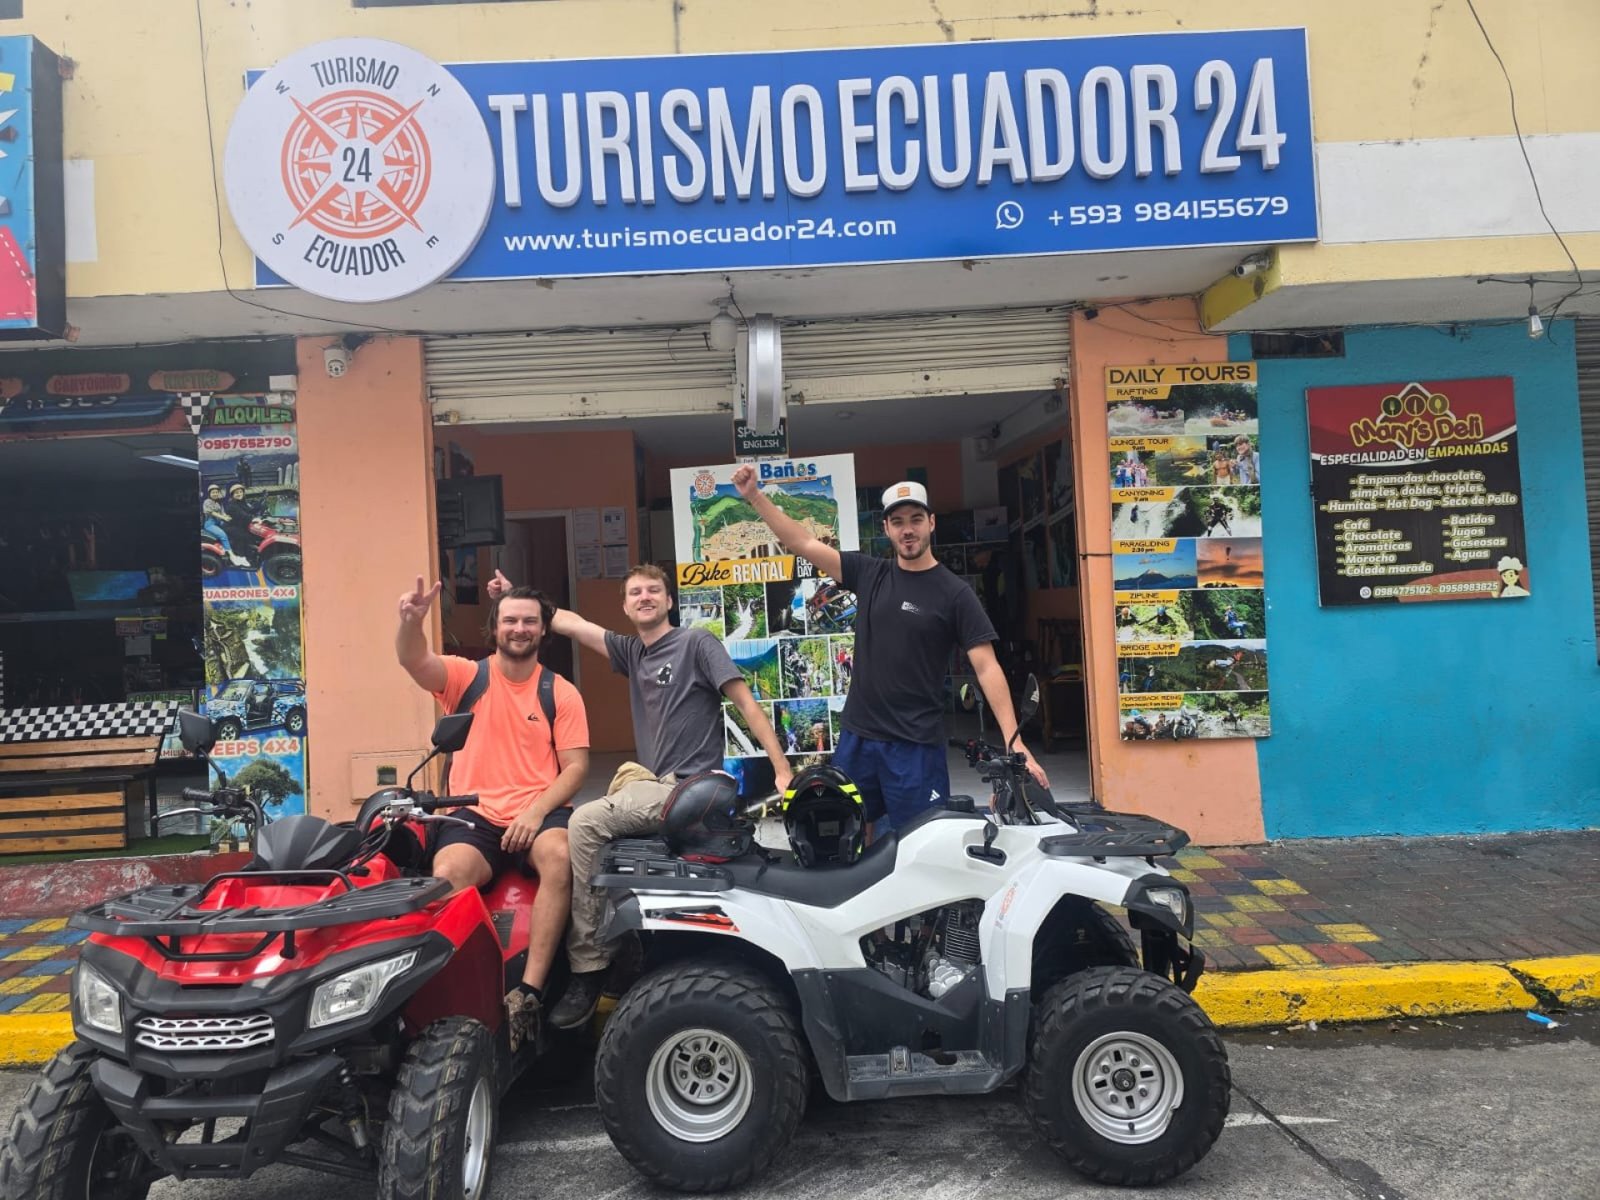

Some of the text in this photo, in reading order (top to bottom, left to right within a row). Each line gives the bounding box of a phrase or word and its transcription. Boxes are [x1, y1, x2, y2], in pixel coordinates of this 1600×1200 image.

[310, 55, 401, 90] TURISMO
[488, 55, 1287, 208] TURISMO ECUADOR 24
[342, 147, 372, 183] 24
[1134, 194, 1290, 223] 984155679
[303, 233, 406, 276] ECUADOR
[1110, 365, 1251, 384] DAILY TOURS
[214, 407, 293, 424] ALQUILER
[1351, 413, 1483, 447] Mary's Deli
[203, 437, 292, 450] 0967652790
[743, 439, 780, 449] ENGLISH
[1111, 438, 1169, 447] JUNGLE TOUR
[1320, 443, 1508, 466] ESPECIALIDAD EN EMPANADAS
[760, 461, 817, 479] Baños
[1358, 475, 1423, 486] Empanadas
[1118, 489, 1165, 498] CANYONING
[1329, 501, 1377, 511] Humitas
[1387, 499, 1407, 509] Hot
[1411, 499, 1432, 511] Dog
[1443, 497, 1467, 507] Seco
[1471, 497, 1484, 506] de
[1487, 495, 1517, 505] Pollo
[1343, 519, 1370, 530] Café
[1450, 515, 1494, 525] Batidos
[1343, 531, 1401, 541] Chocolate
[1451, 528, 1484, 538] Jugos
[1119, 541, 1170, 550] PARAGLIDING
[1452, 538, 1507, 548] Gaseosas
[1345, 554, 1396, 563] Morocho
[1453, 550, 1489, 561] Aguas
[680, 562, 788, 586] Bike RENTAL
[797, 565, 813, 578] DAY
[1346, 564, 1433, 576] Colada morada
[273, 588, 296, 597] 4X4
[1129, 592, 1160, 600] ZIPLINE
[1120, 644, 1150, 652] BRIDGE
[1120, 694, 1159, 702] HORSEBACK
[264, 739, 298, 752] 4X4
